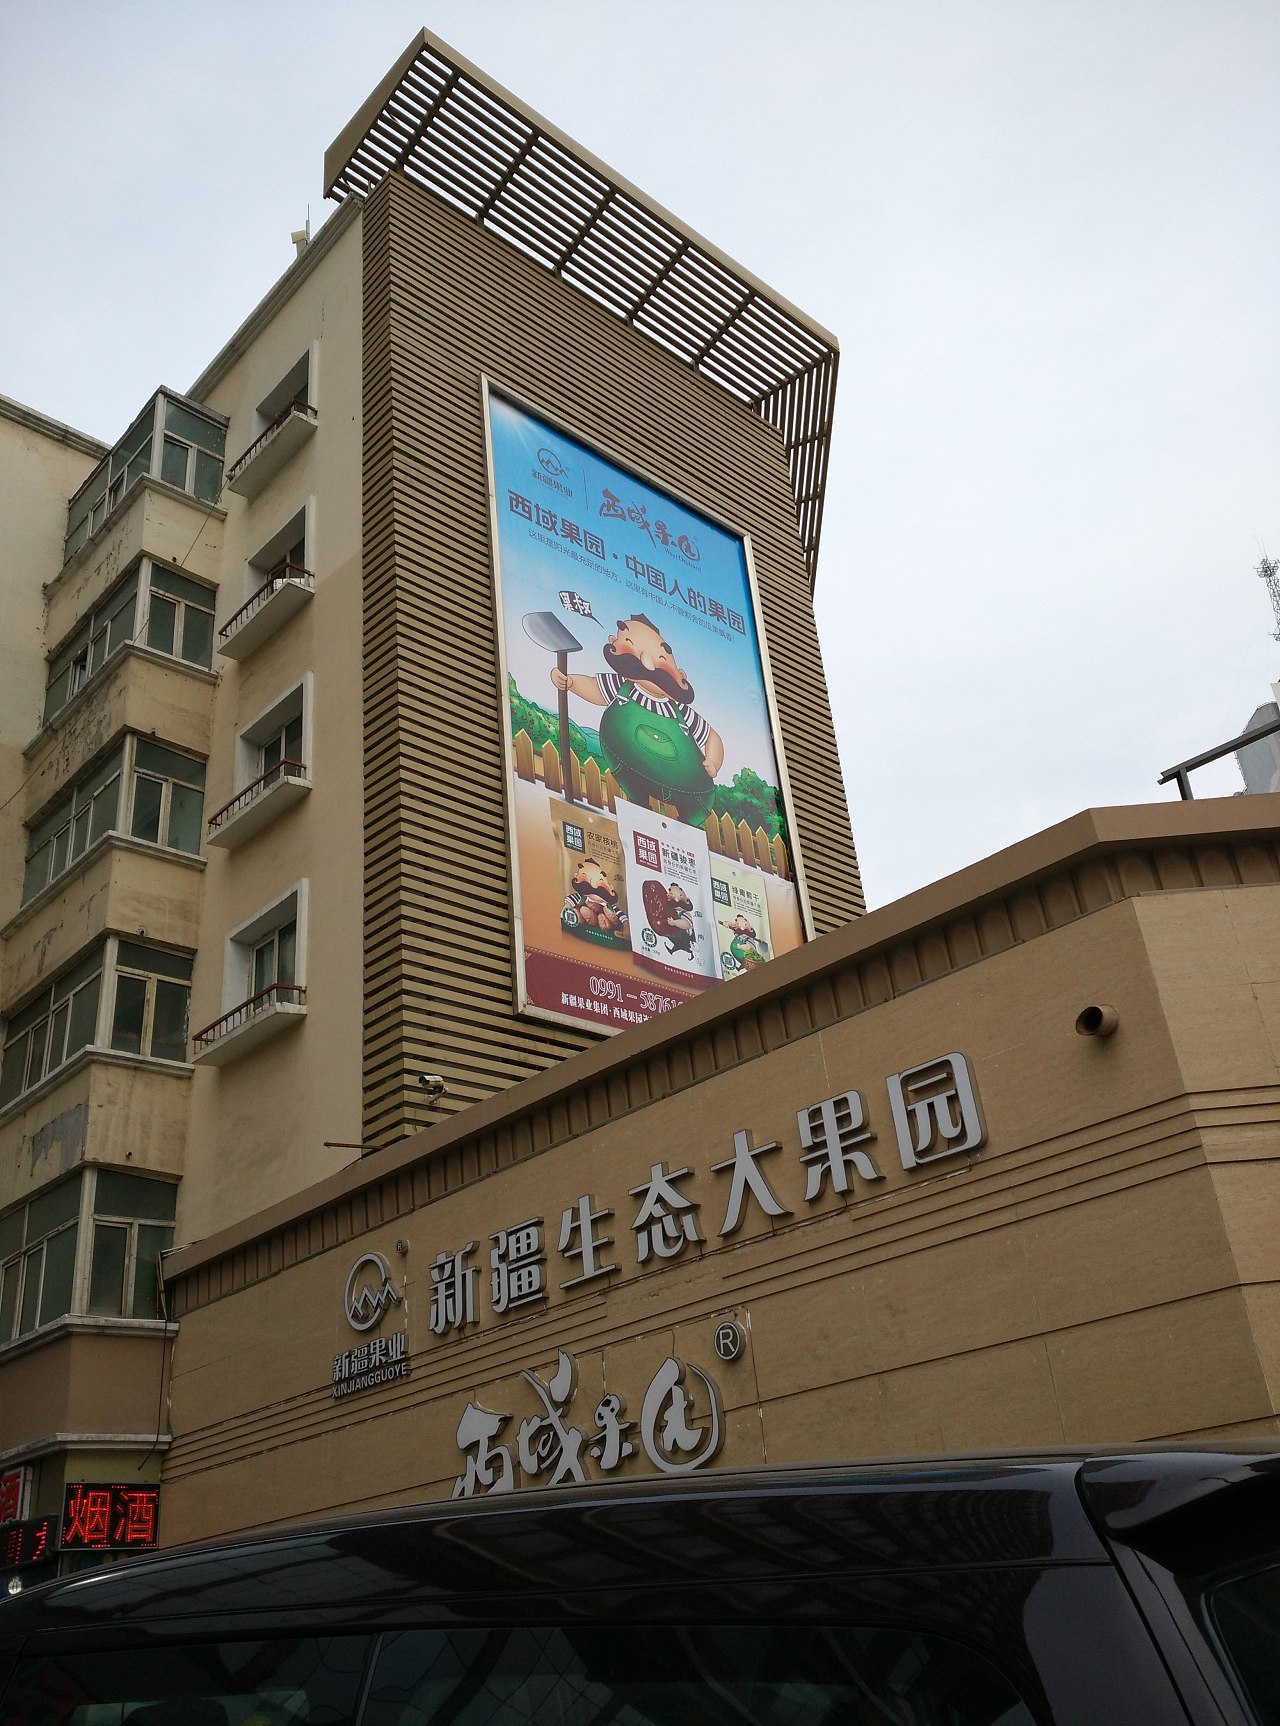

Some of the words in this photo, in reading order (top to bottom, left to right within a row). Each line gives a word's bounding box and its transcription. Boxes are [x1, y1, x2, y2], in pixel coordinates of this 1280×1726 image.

[428, 1051, 988, 1335] 新疆生态大果园
[331, 1362, 410, 1398] XINJIANGGUOYE
[332, 1331, 408, 1382] 新疆果业
[65, 1488, 157, 1543] 烟酒
